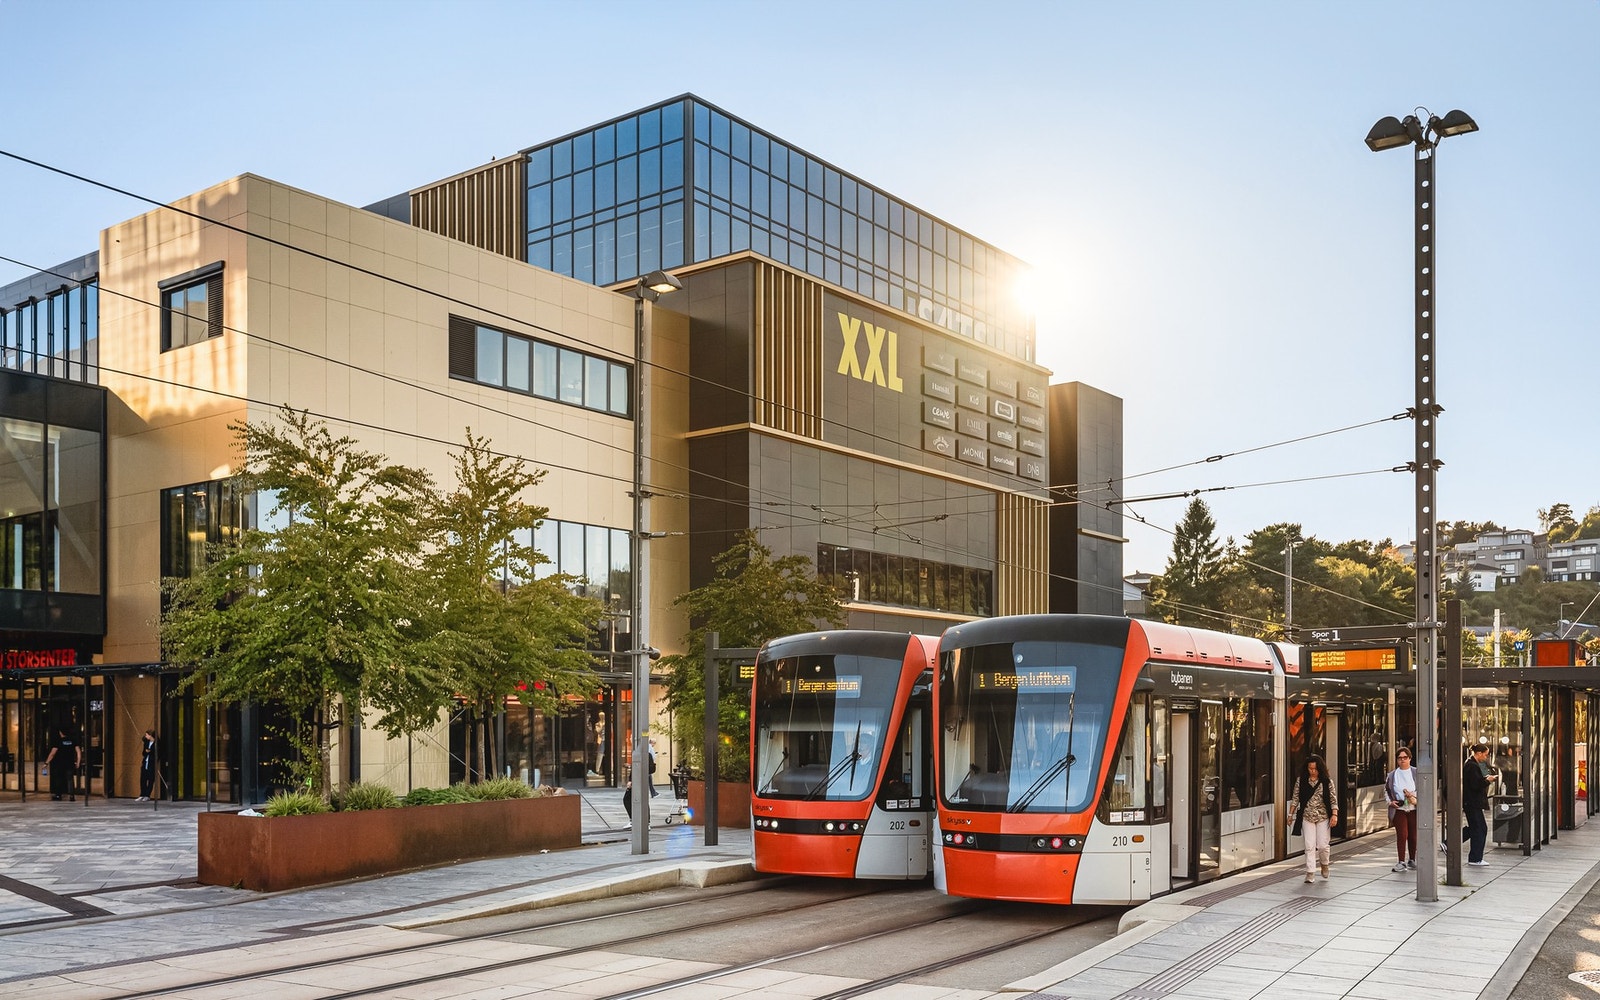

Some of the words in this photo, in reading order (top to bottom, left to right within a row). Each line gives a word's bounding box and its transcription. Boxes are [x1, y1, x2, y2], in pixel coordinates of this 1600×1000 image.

[837, 312, 903, 393] XXL
[1311, 630, 1330, 639] Spor
[1332, 629, 1341, 641] 1
[1515, 642, 1524, 650] W
[6, 648, 76, 670] STORSENTER
[979, 673, 985, 688] 1
[994, 672, 1028, 690] Bergen
[1170, 670, 1193, 686] bybanen
[786, 680, 791, 693] 1
[798, 679, 826, 693] Bergen
[889, 821, 905, 830] 202
[1112, 835, 1128, 847] 210
